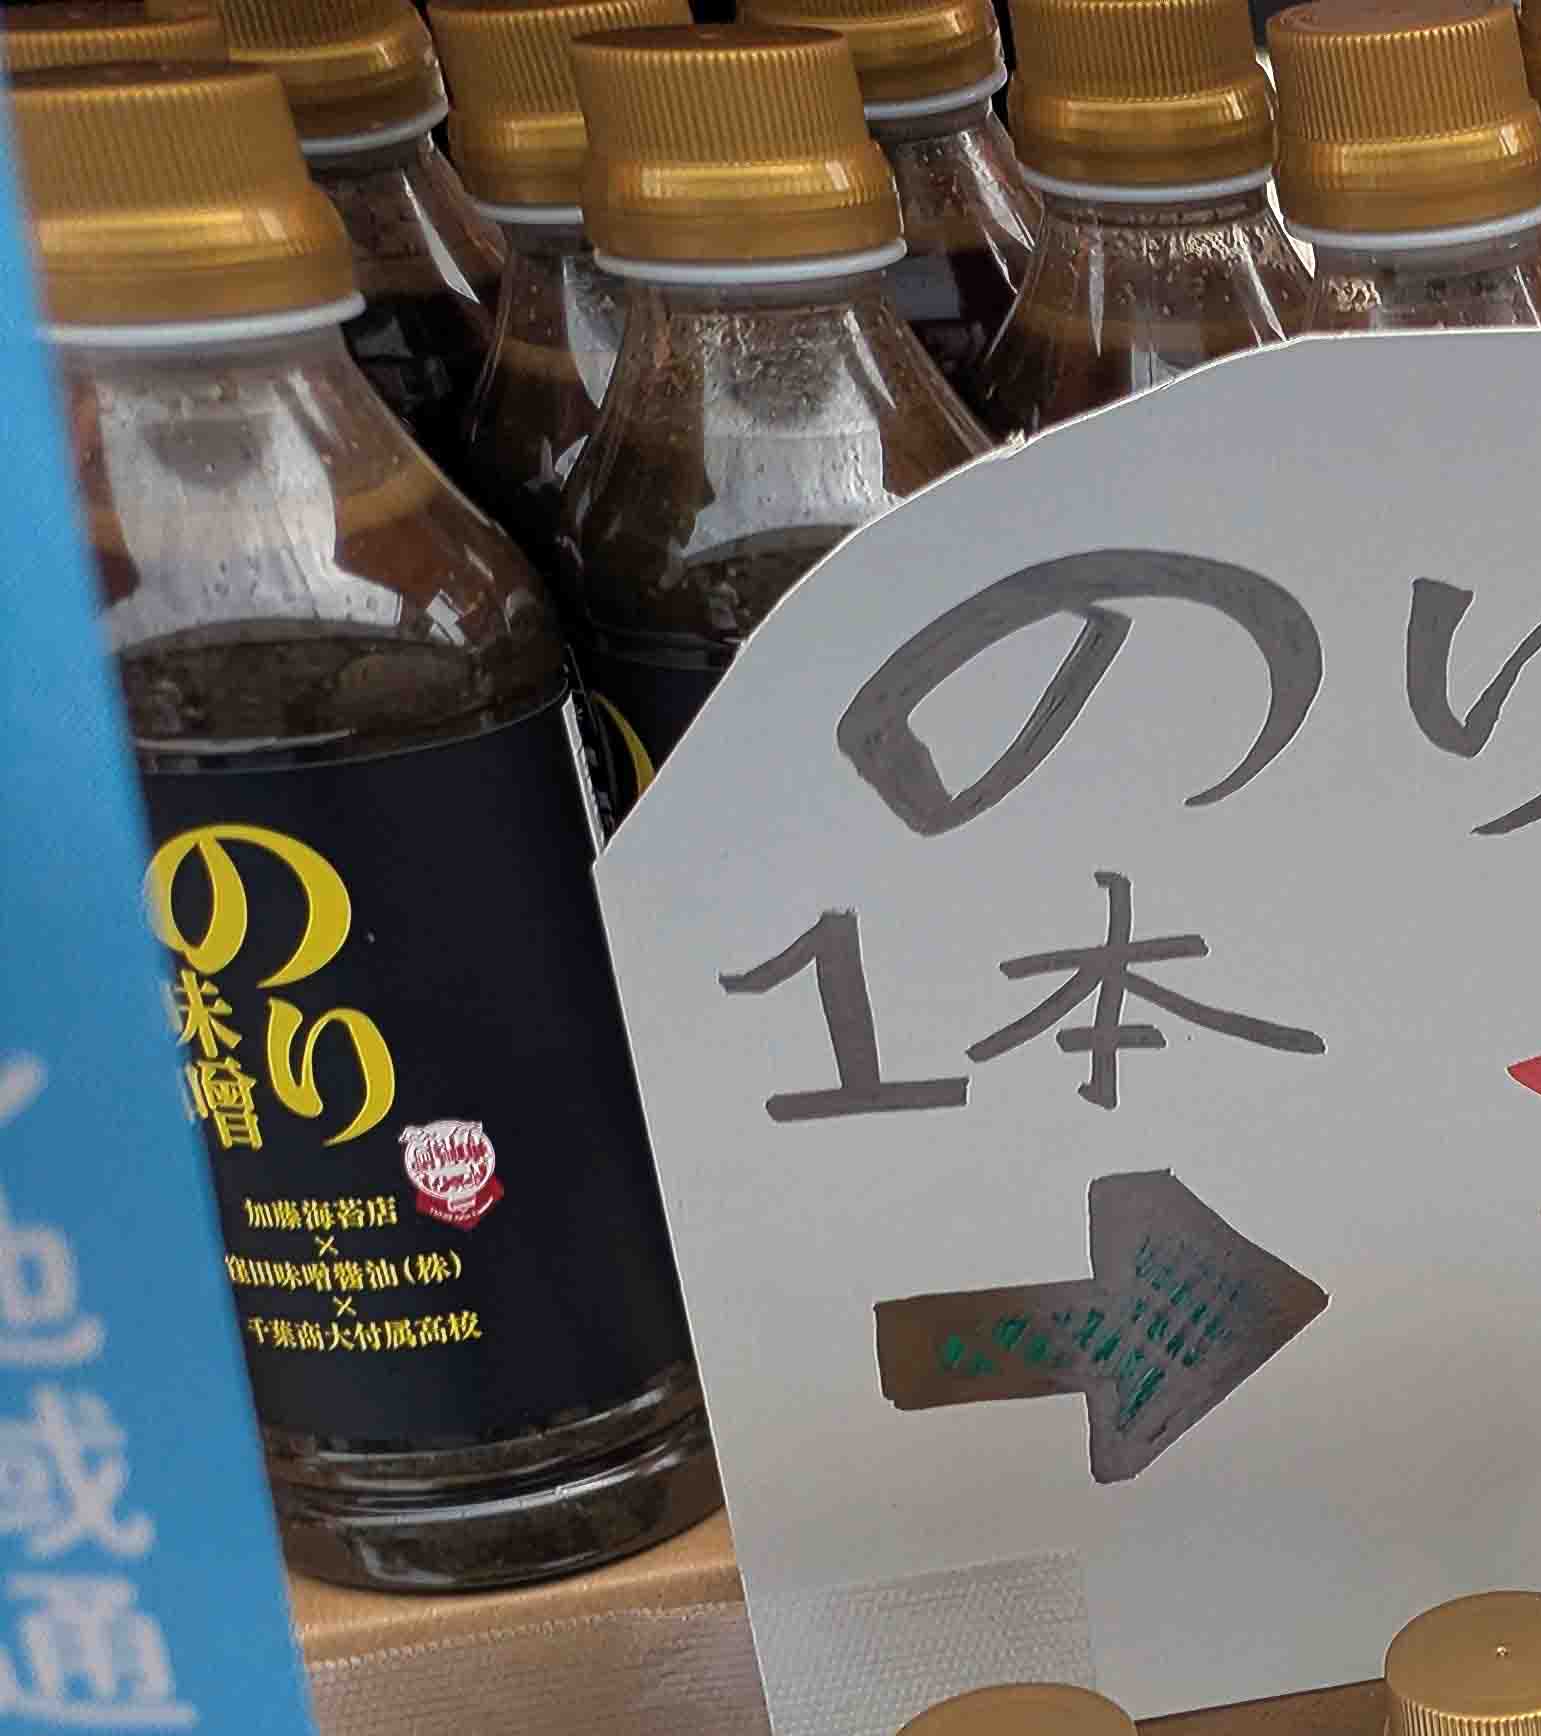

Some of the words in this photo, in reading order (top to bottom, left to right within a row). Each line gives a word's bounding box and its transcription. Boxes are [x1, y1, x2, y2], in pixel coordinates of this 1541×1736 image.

[143, 824, 397, 1147] のり
[166, 969, 263, 1152] 味噌
[720, 872, 1324, 1123] 1本
[244, 1196, 398, 1230] 加藤海苔店
[248, 1311, 483, 1352] 千葉商大付属高校
